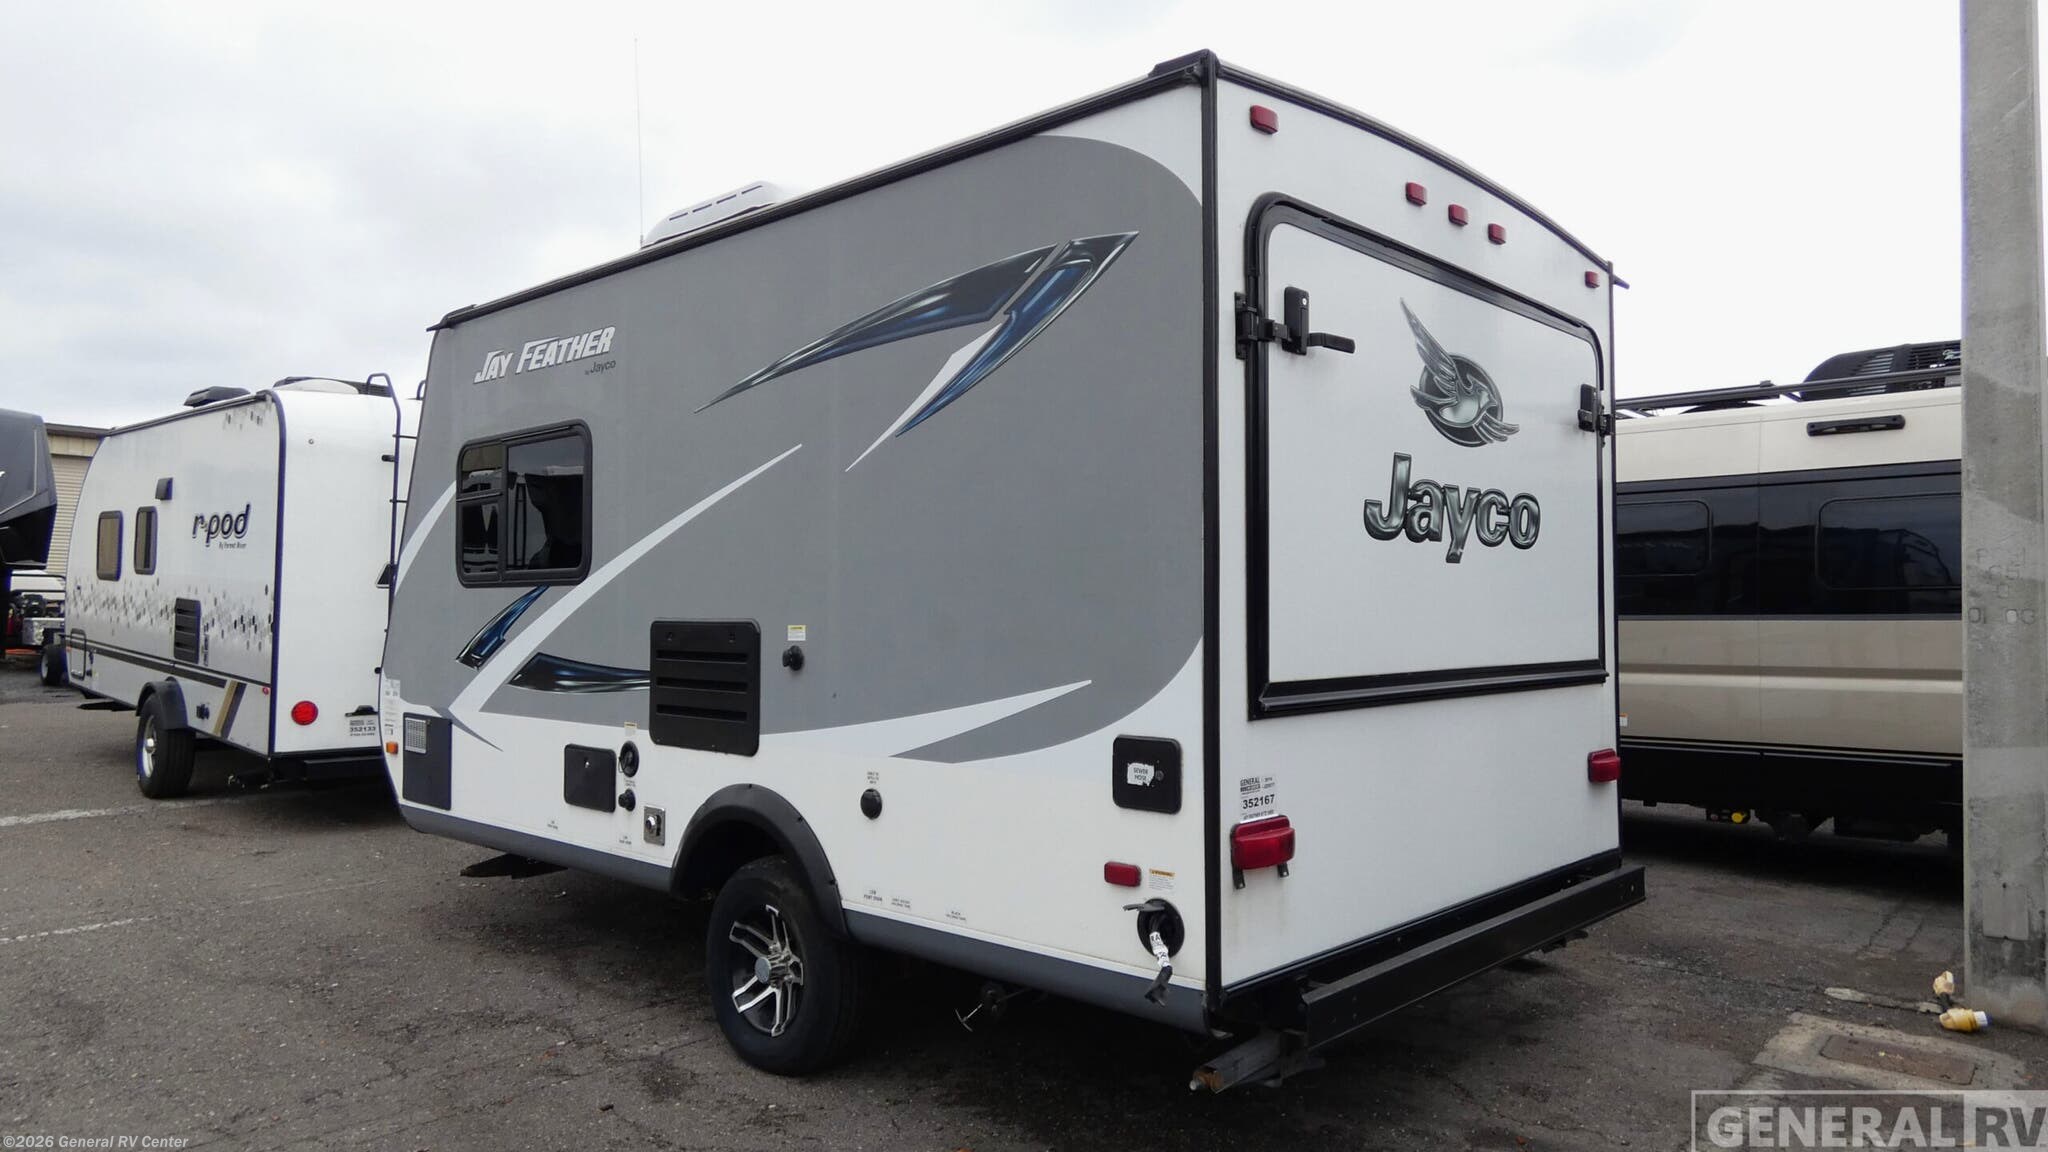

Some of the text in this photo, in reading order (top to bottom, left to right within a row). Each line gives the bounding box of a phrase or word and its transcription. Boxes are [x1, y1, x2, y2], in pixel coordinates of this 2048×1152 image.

[473, 325, 616, 384] JAY FEATHER
[590, 360, 617, 374] Jayco
[1363, 452, 1541, 564] Jayco
[1242, 793, 1275, 809] 352167
